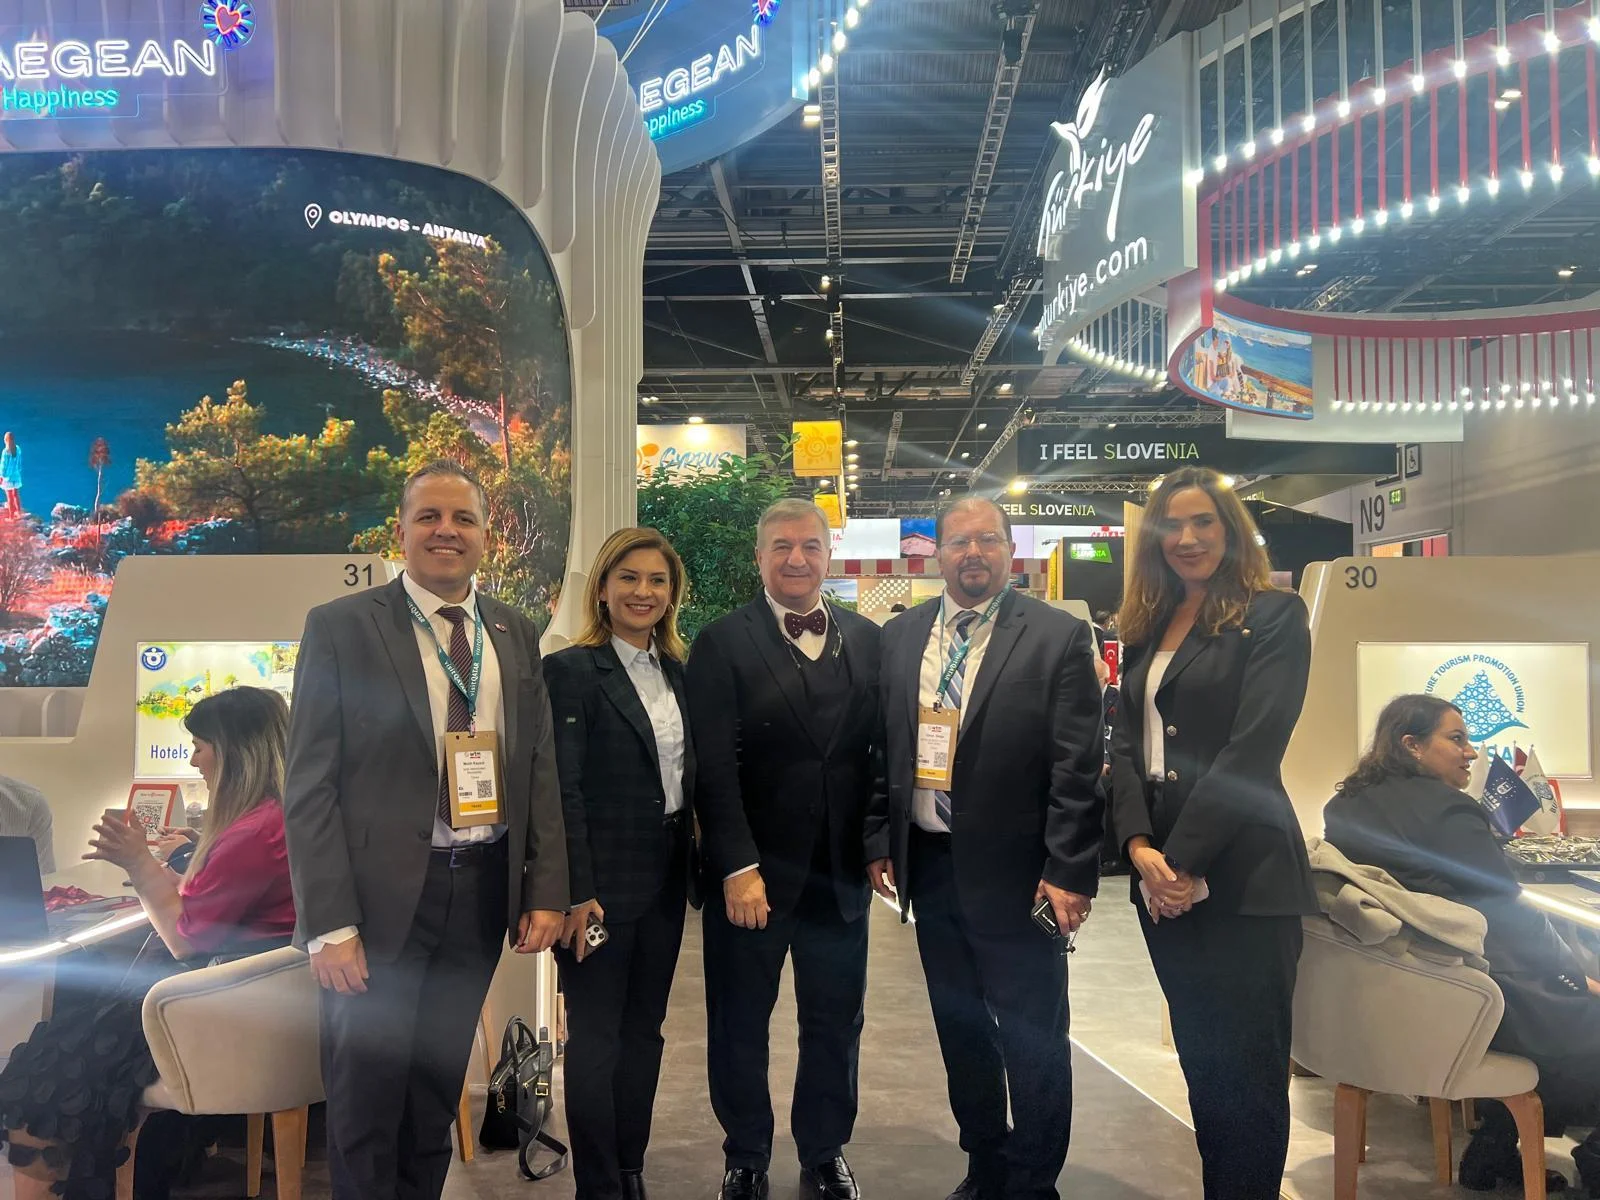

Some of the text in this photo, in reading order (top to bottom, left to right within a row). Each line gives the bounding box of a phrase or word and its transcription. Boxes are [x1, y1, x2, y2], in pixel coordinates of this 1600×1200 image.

[2, 83, 119, 115] Happiness
[328, 210, 411, 232] OLYMPOS
[421, 222, 487, 249] ANTALYA
[1039, 443, 1200, 460] I FEEL SLOVENIA
[1030, 503, 1096, 517] SLOVENIA
[1360, 494, 1386, 535] N9
[343, 563, 373, 587] 31
[1344, 566, 1378, 589] 30
[1434, 654, 1471, 676] TOURISM
[1472, 654, 1519, 685] PROMOTION
[1513, 685, 1525, 713] UNION
[150, 743, 189, 760] Hotels
